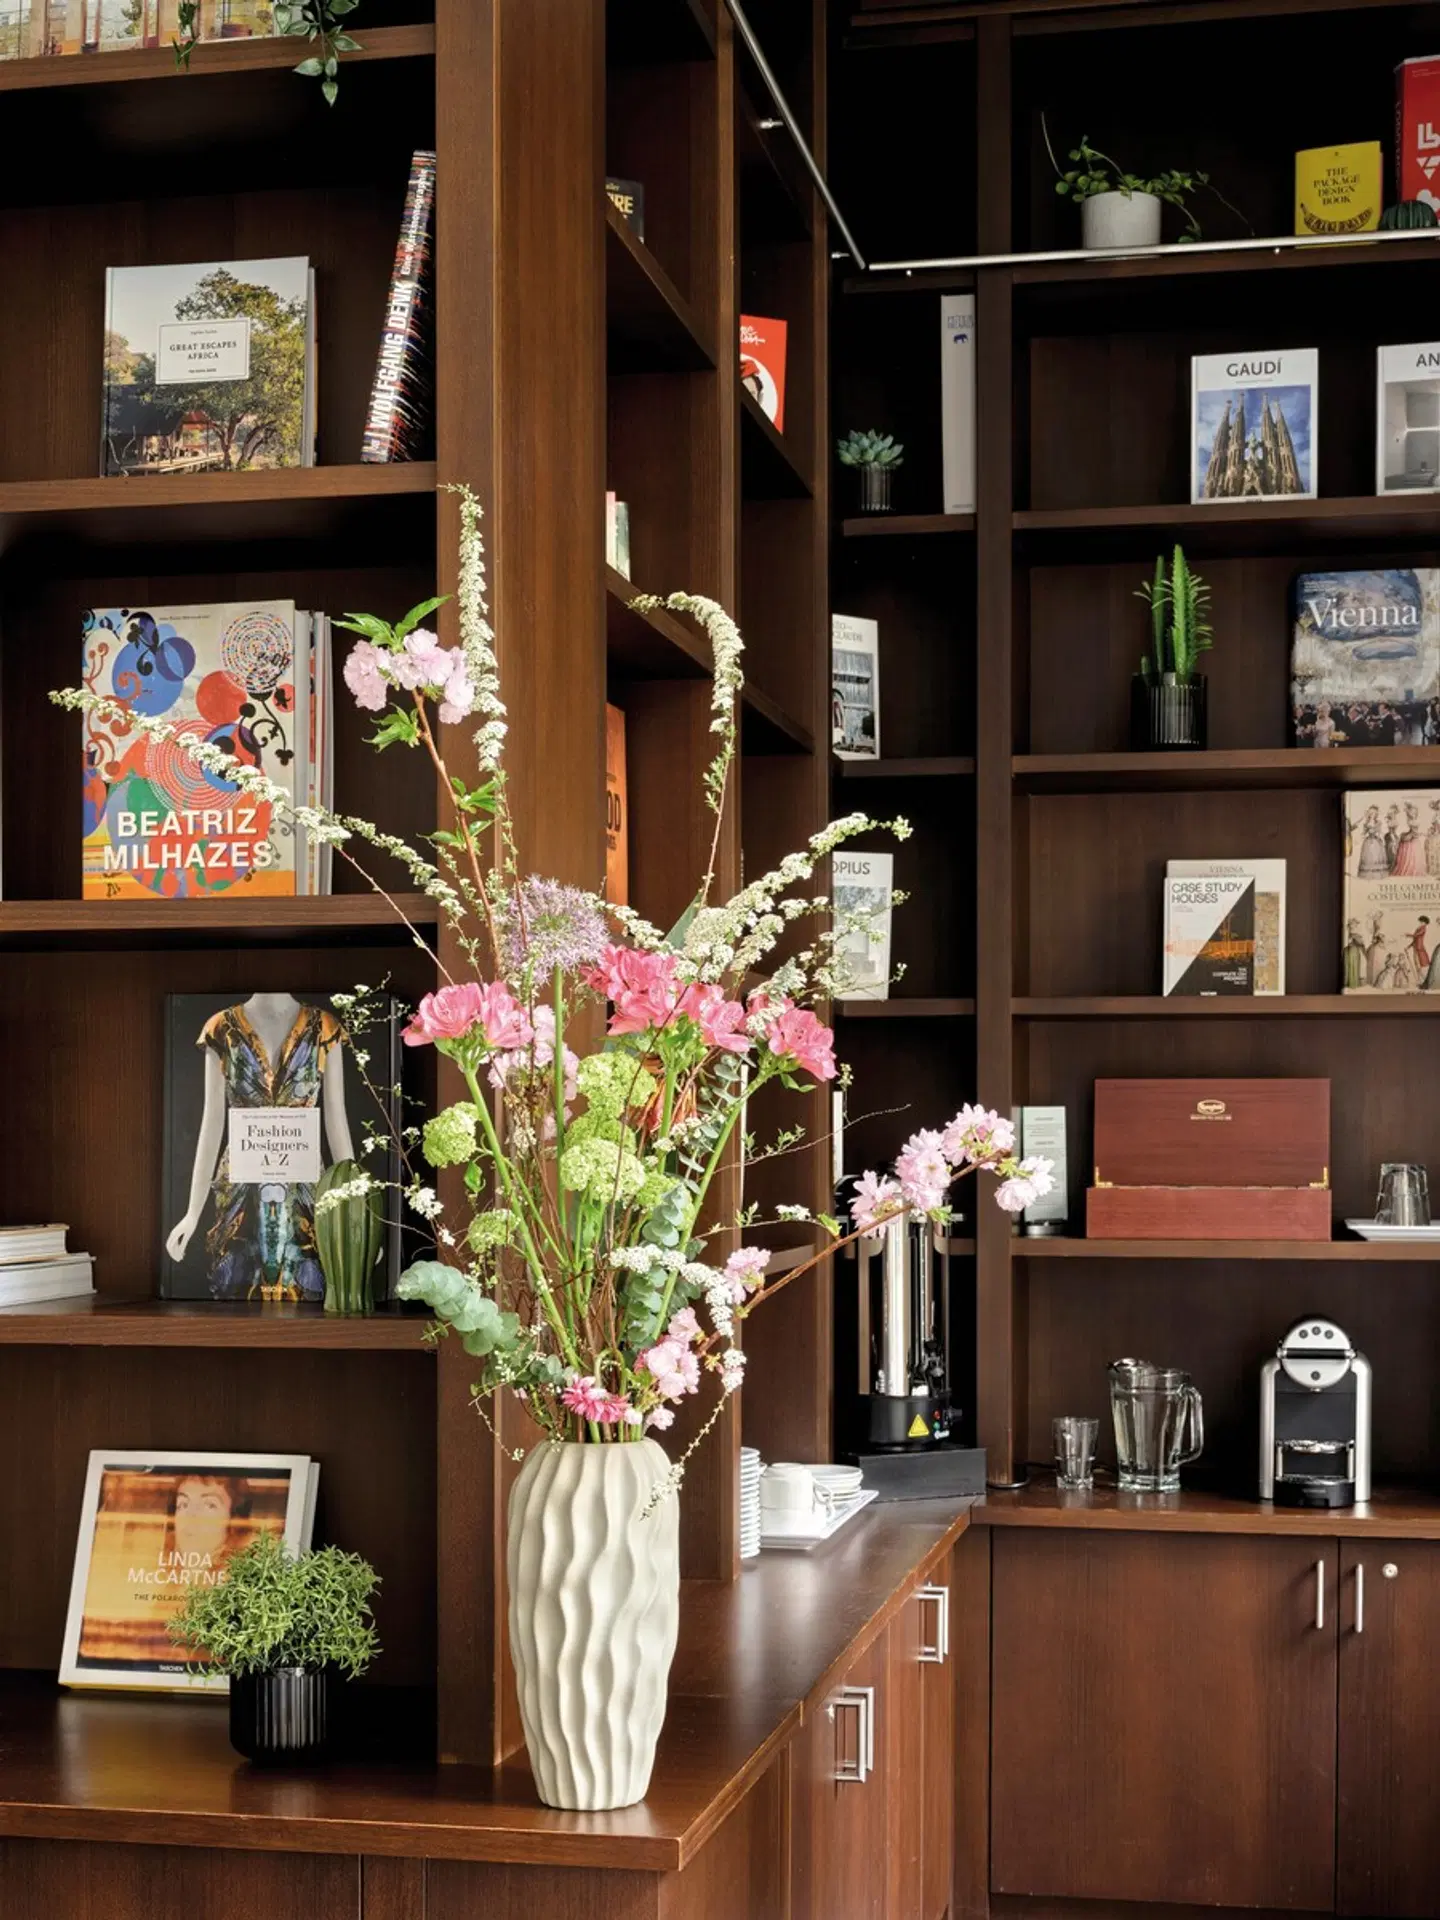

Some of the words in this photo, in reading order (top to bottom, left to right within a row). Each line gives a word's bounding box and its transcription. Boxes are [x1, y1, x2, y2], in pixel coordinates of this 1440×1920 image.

[169, 343, 198, 352] GREAT
[201, 341, 237, 351] ESCAPES
[187, 352, 219, 360] AFRICA
[370, 332, 405, 428] WOLFGANG
[388, 280, 414, 328] DENK
[1226, 357, 1282, 377] GAUDÍ
[1305, 598, 1420, 629] Vienna
[117, 808, 258, 837] BEATRIZ
[103, 840, 273, 871] MILHAZES
[1171, 883, 1201, 894] CASE
[1205, 882, 1242, 893] STUDY
[1171, 893, 1219, 904] HOUSES
[247, 1125, 302, 1137] Fashion
[241, 1139, 309, 1153] Designers
[158, 1551, 213, 1568] LINDA
[134, 1593, 149, 1601] THE
